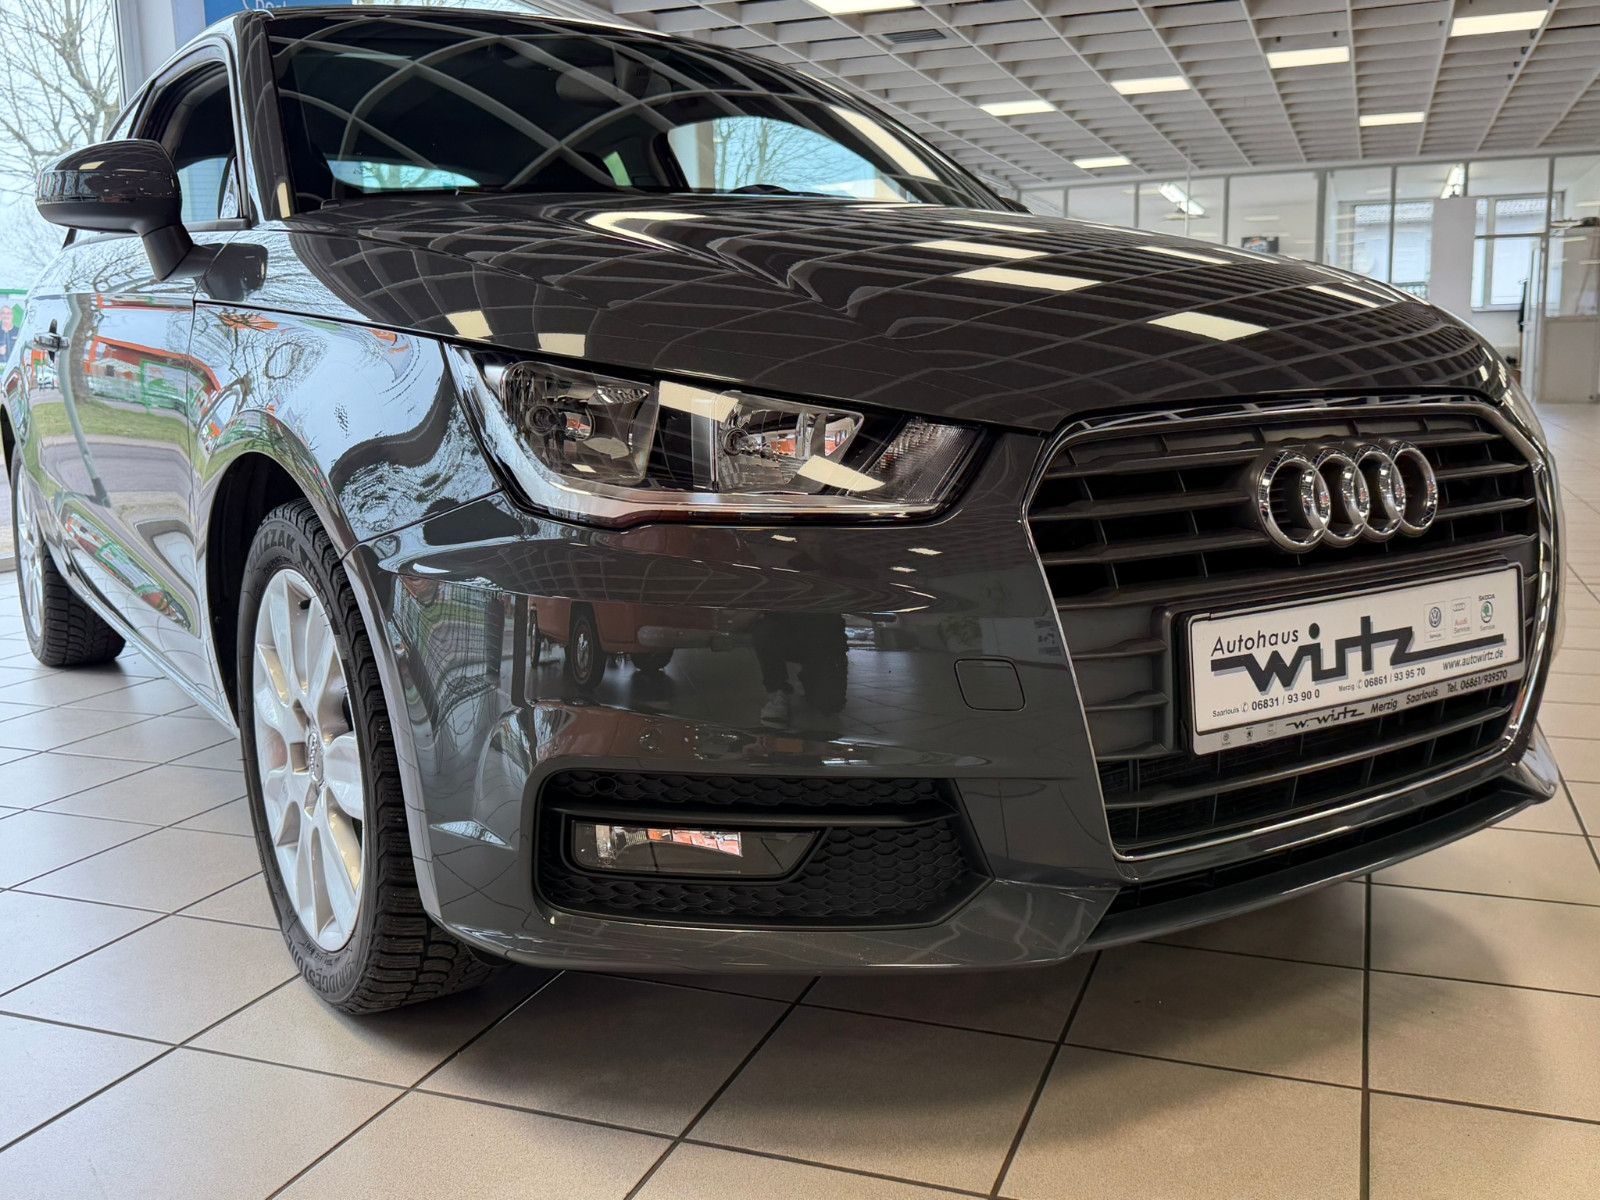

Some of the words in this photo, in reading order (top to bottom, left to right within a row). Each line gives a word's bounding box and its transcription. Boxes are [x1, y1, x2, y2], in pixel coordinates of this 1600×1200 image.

[1210, 629, 1299, 656] Autohaus
[1443, 649, 1504, 670] www.autowirtz.de
[1338, 684, 1355, 692] Merzig
[1364, 675, 1387, 688] 06861
[1394, 672, 1403, 682] 93
[1405, 669, 1415, 680] 95
[1416, 667, 1426, 677] 70
[1370, 699, 1398, 713] Merzig
[1406, 687, 1439, 704] Saarlouis
[1447, 681, 1458, 693] Tel.
[1460, 670, 1508, 690] 06861/939570
[1212, 707, 1239, 718] Saarlouis
[1251, 697, 1279, 711] 06831
[1287, 693, 1299, 703] 93
[1301, 691, 1312, 700] 90
[1314, 689, 1320, 698] 0
